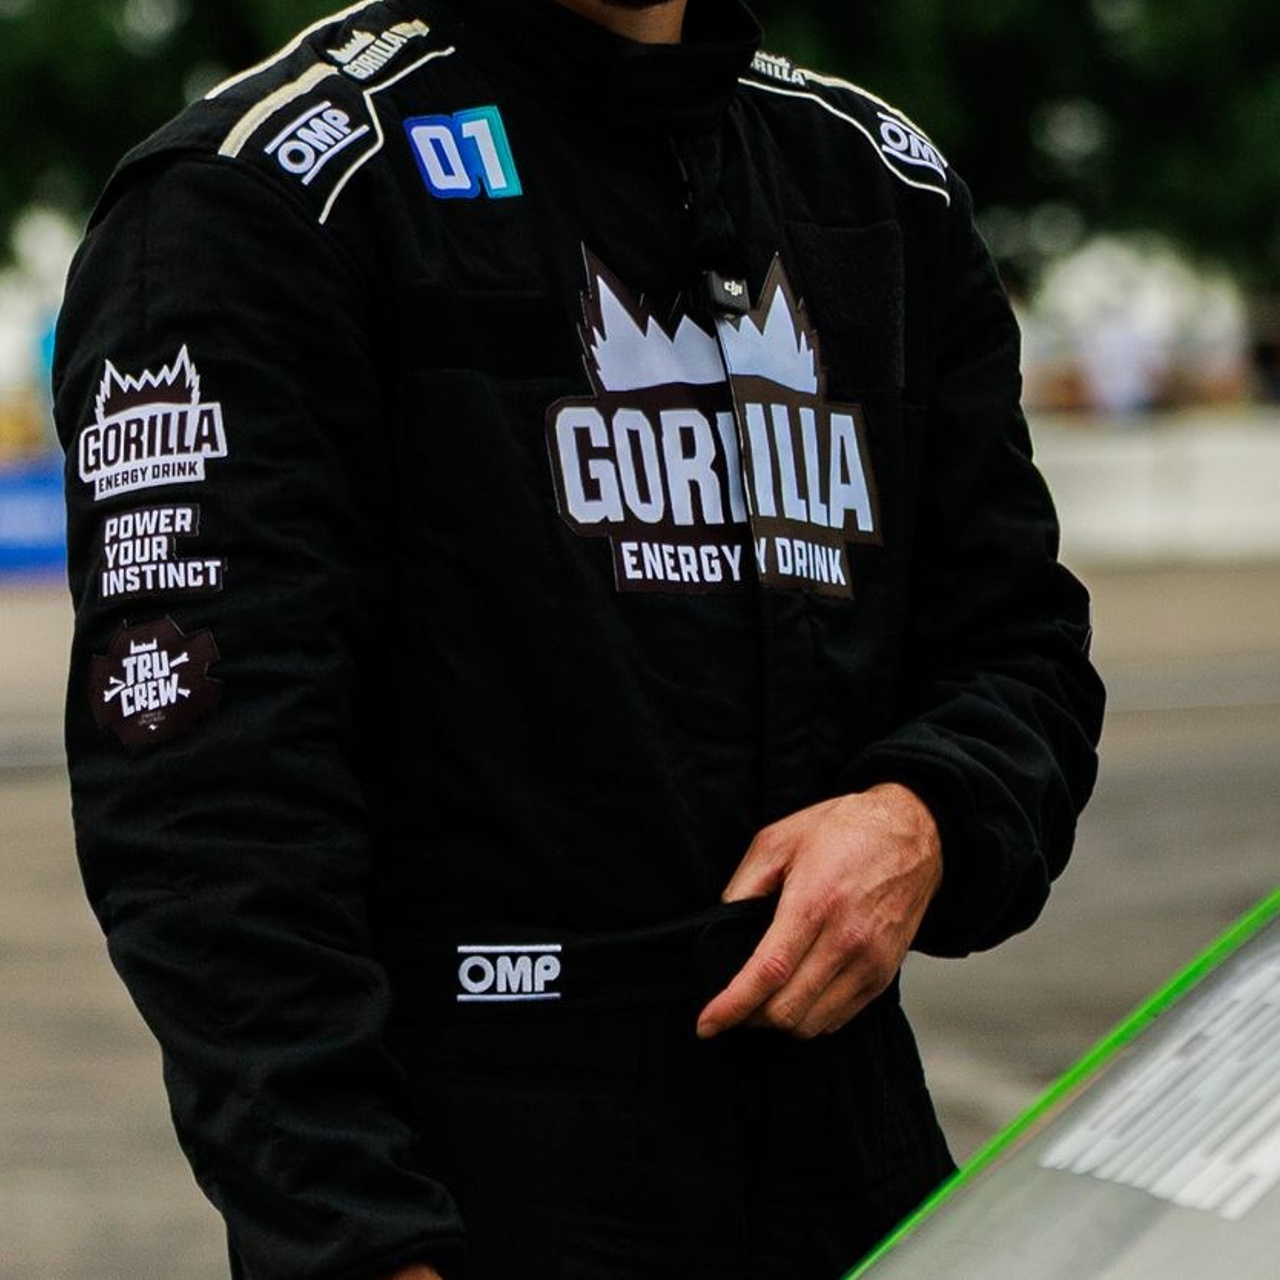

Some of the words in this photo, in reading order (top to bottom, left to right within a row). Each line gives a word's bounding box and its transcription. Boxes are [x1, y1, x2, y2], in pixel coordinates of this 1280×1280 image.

[750, 57, 805, 86] RILLA
[278, 108, 351, 175] OMP
[410, 118, 507, 191] 01
[82, 408, 221, 475] GORILLA
[99, 466, 149, 493] ENERGY
[152, 460, 199, 480] DRINK
[104, 507, 193, 544] POWER
[104, 535, 168, 569] YOUR
[775, 537, 847, 586] DRINK
[102, 560, 222, 598] INSTINCT
[122, 650, 170, 687] TRU
[120, 672, 179, 718] CREW
[457, 954, 562, 994] OMP
